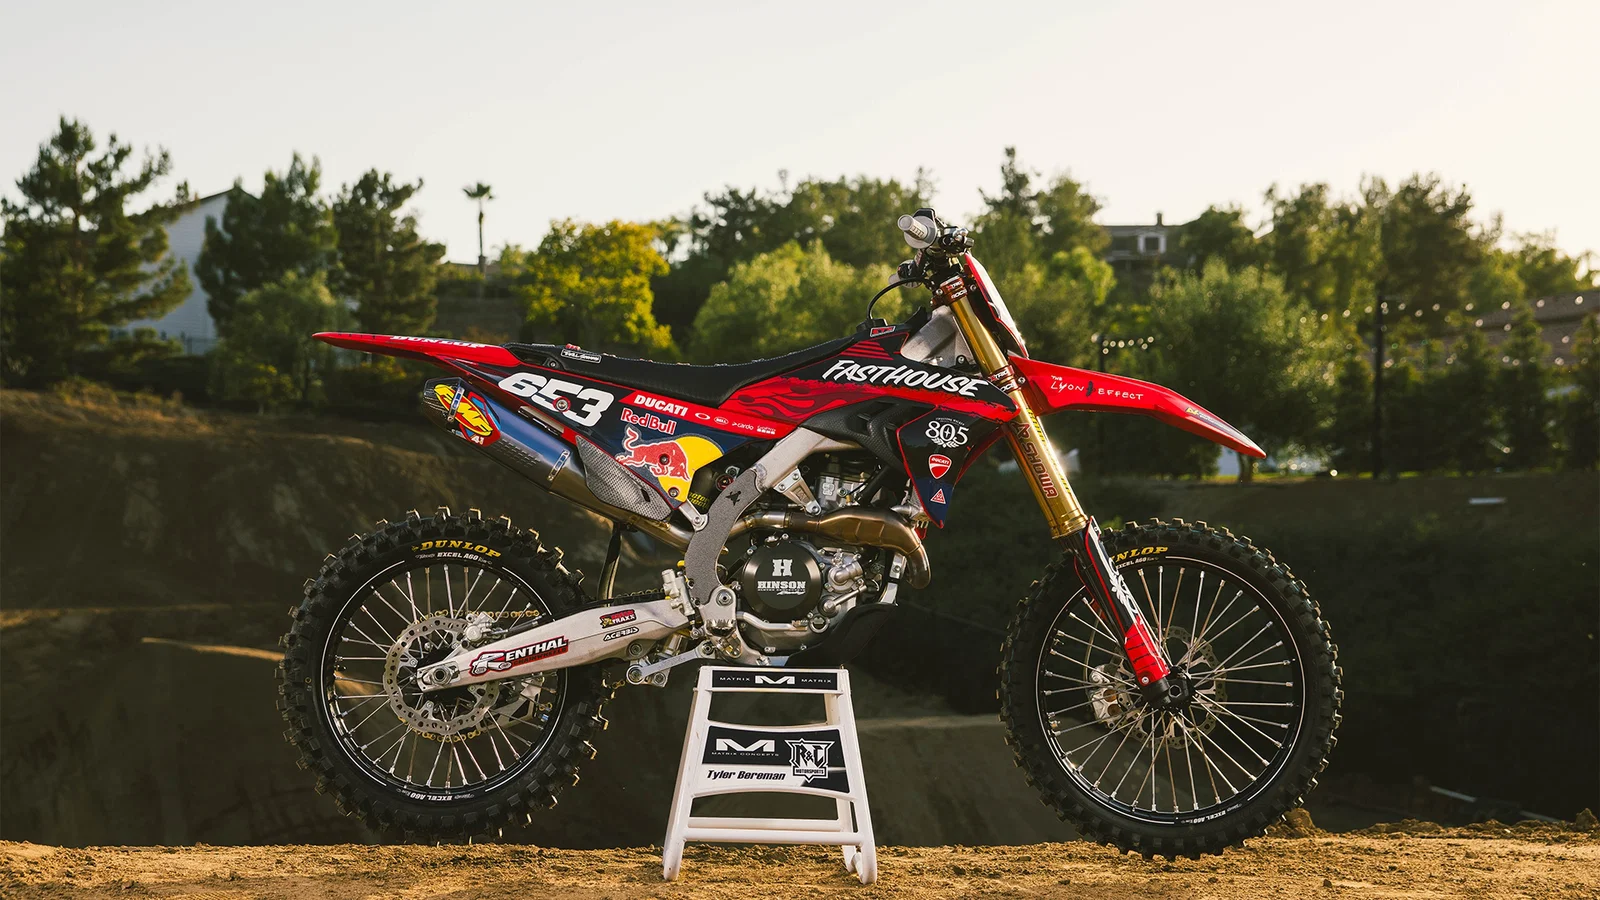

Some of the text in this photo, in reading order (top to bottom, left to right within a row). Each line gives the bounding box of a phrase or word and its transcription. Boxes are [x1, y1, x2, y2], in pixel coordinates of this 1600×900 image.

[822, 360, 989, 397] FASTHOUSE
[498, 372, 614, 427] 653
[1050, 381, 1144, 400] LYON EFFECT
[633, 394, 688, 417] DUCATI
[737, 422, 754, 431] cardo
[925, 420, 969, 446] 805
[931, 457, 949, 465] DUCATI
[1021, 442, 1059, 498] SHOWA
[420, 540, 501, 557] DUNLOP
[1112, 547, 1168, 562] NLOP
[772, 559, 792, 576] H
[612, 614, 635, 624] TRAXX
[604, 627, 638, 641] ACERBIS
[471, 638, 567, 675] RENTHAL
[795, 743, 825, 768] R&C
[707, 770, 786, 781] Tyler Bereman
